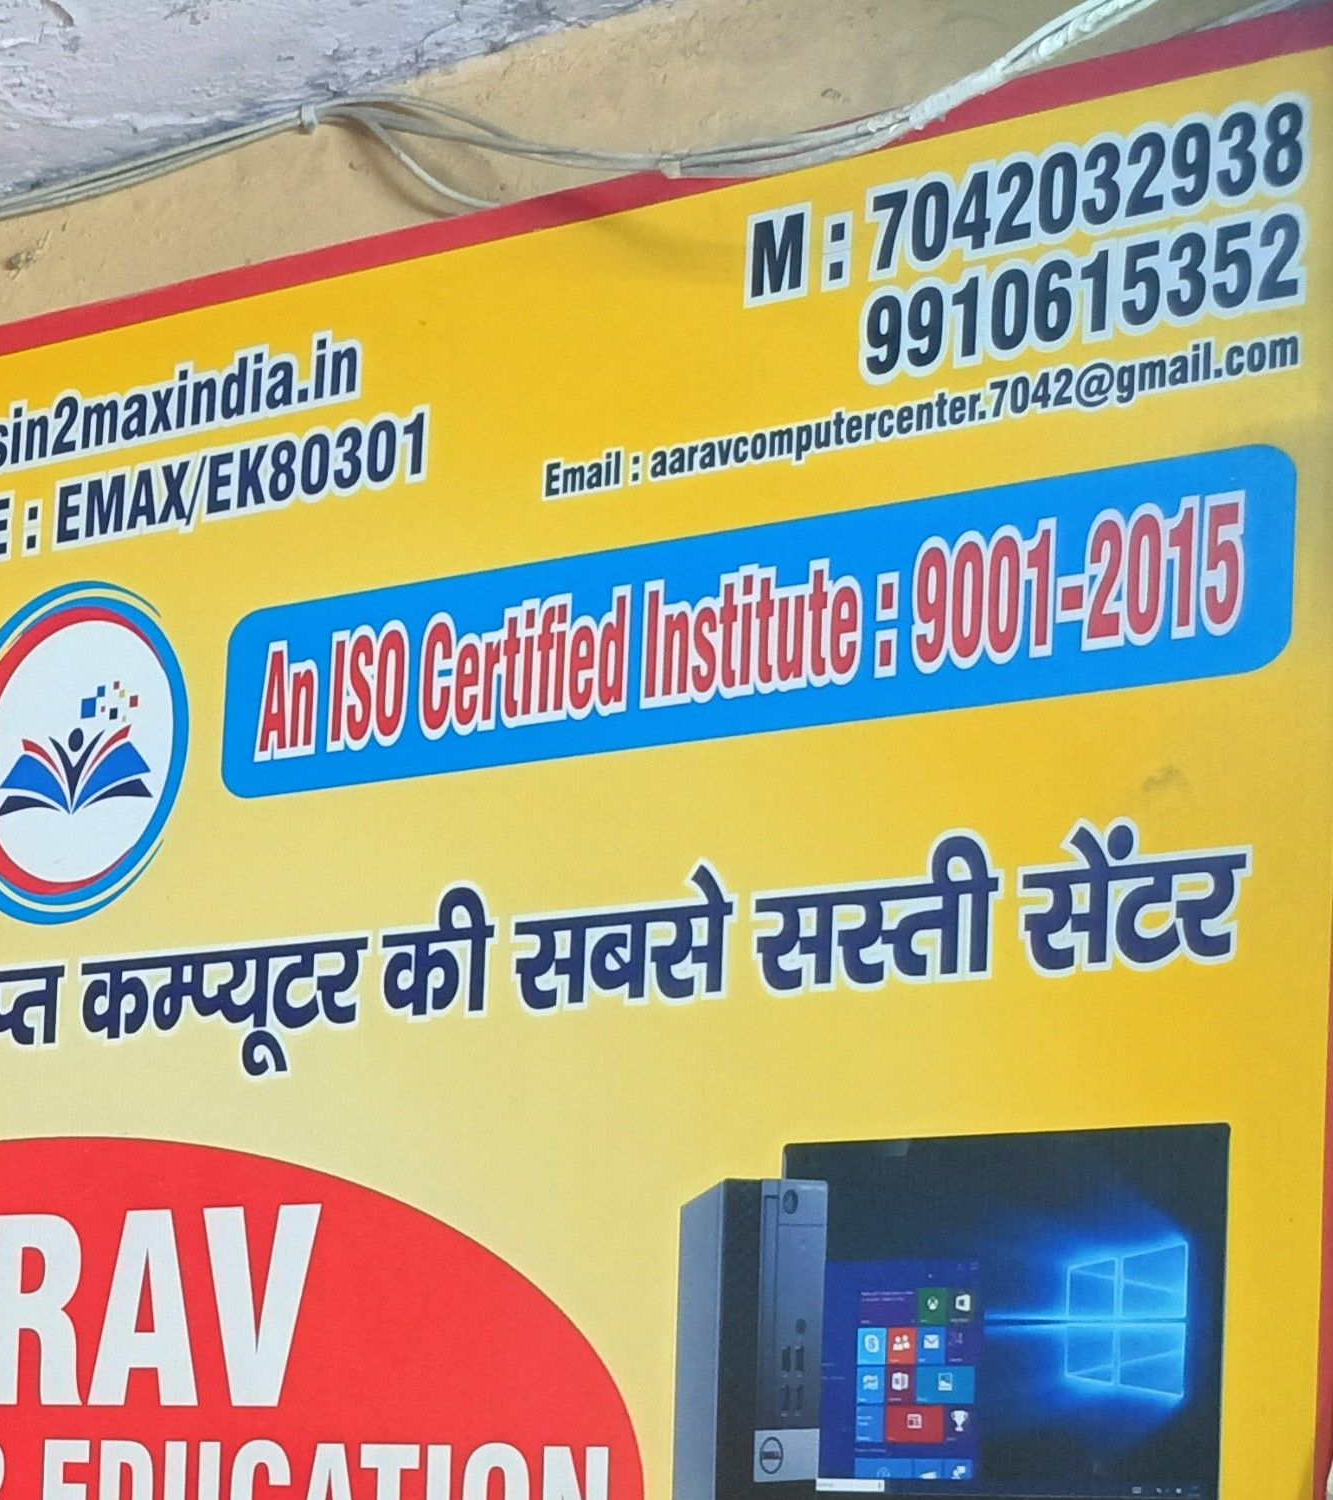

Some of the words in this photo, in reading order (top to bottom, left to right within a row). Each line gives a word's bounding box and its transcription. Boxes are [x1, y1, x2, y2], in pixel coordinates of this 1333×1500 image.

[750, 217, 805, 300] M
[824, 222, 844, 284] :
[874, 106, 1303, 270] 7042032938
[866, 222, 1299, 375] 9910615352
[56, 411, 429, 544] EMAX/EK80301
[545, 456, 623, 498] Email
[650, 332, 1299, 483] aaravcomputercenter.7042@gmail.com
[258, 642, 315, 756] An
[331, 632, 406, 746] ISO
[420, 602, 626, 734] Certified
[645, 560, 862, 699] Institute
[914, 494, 1245, 666] 9001-2015
[80, 937, 369, 1075] कम्प्यूटर
[382, 886, 495, 1017] की
[515, 865, 734, 1011] सबसे
[755, 835, 1000, 992] सस्ती
[1022, 819, 1247, 973] सेंटर
